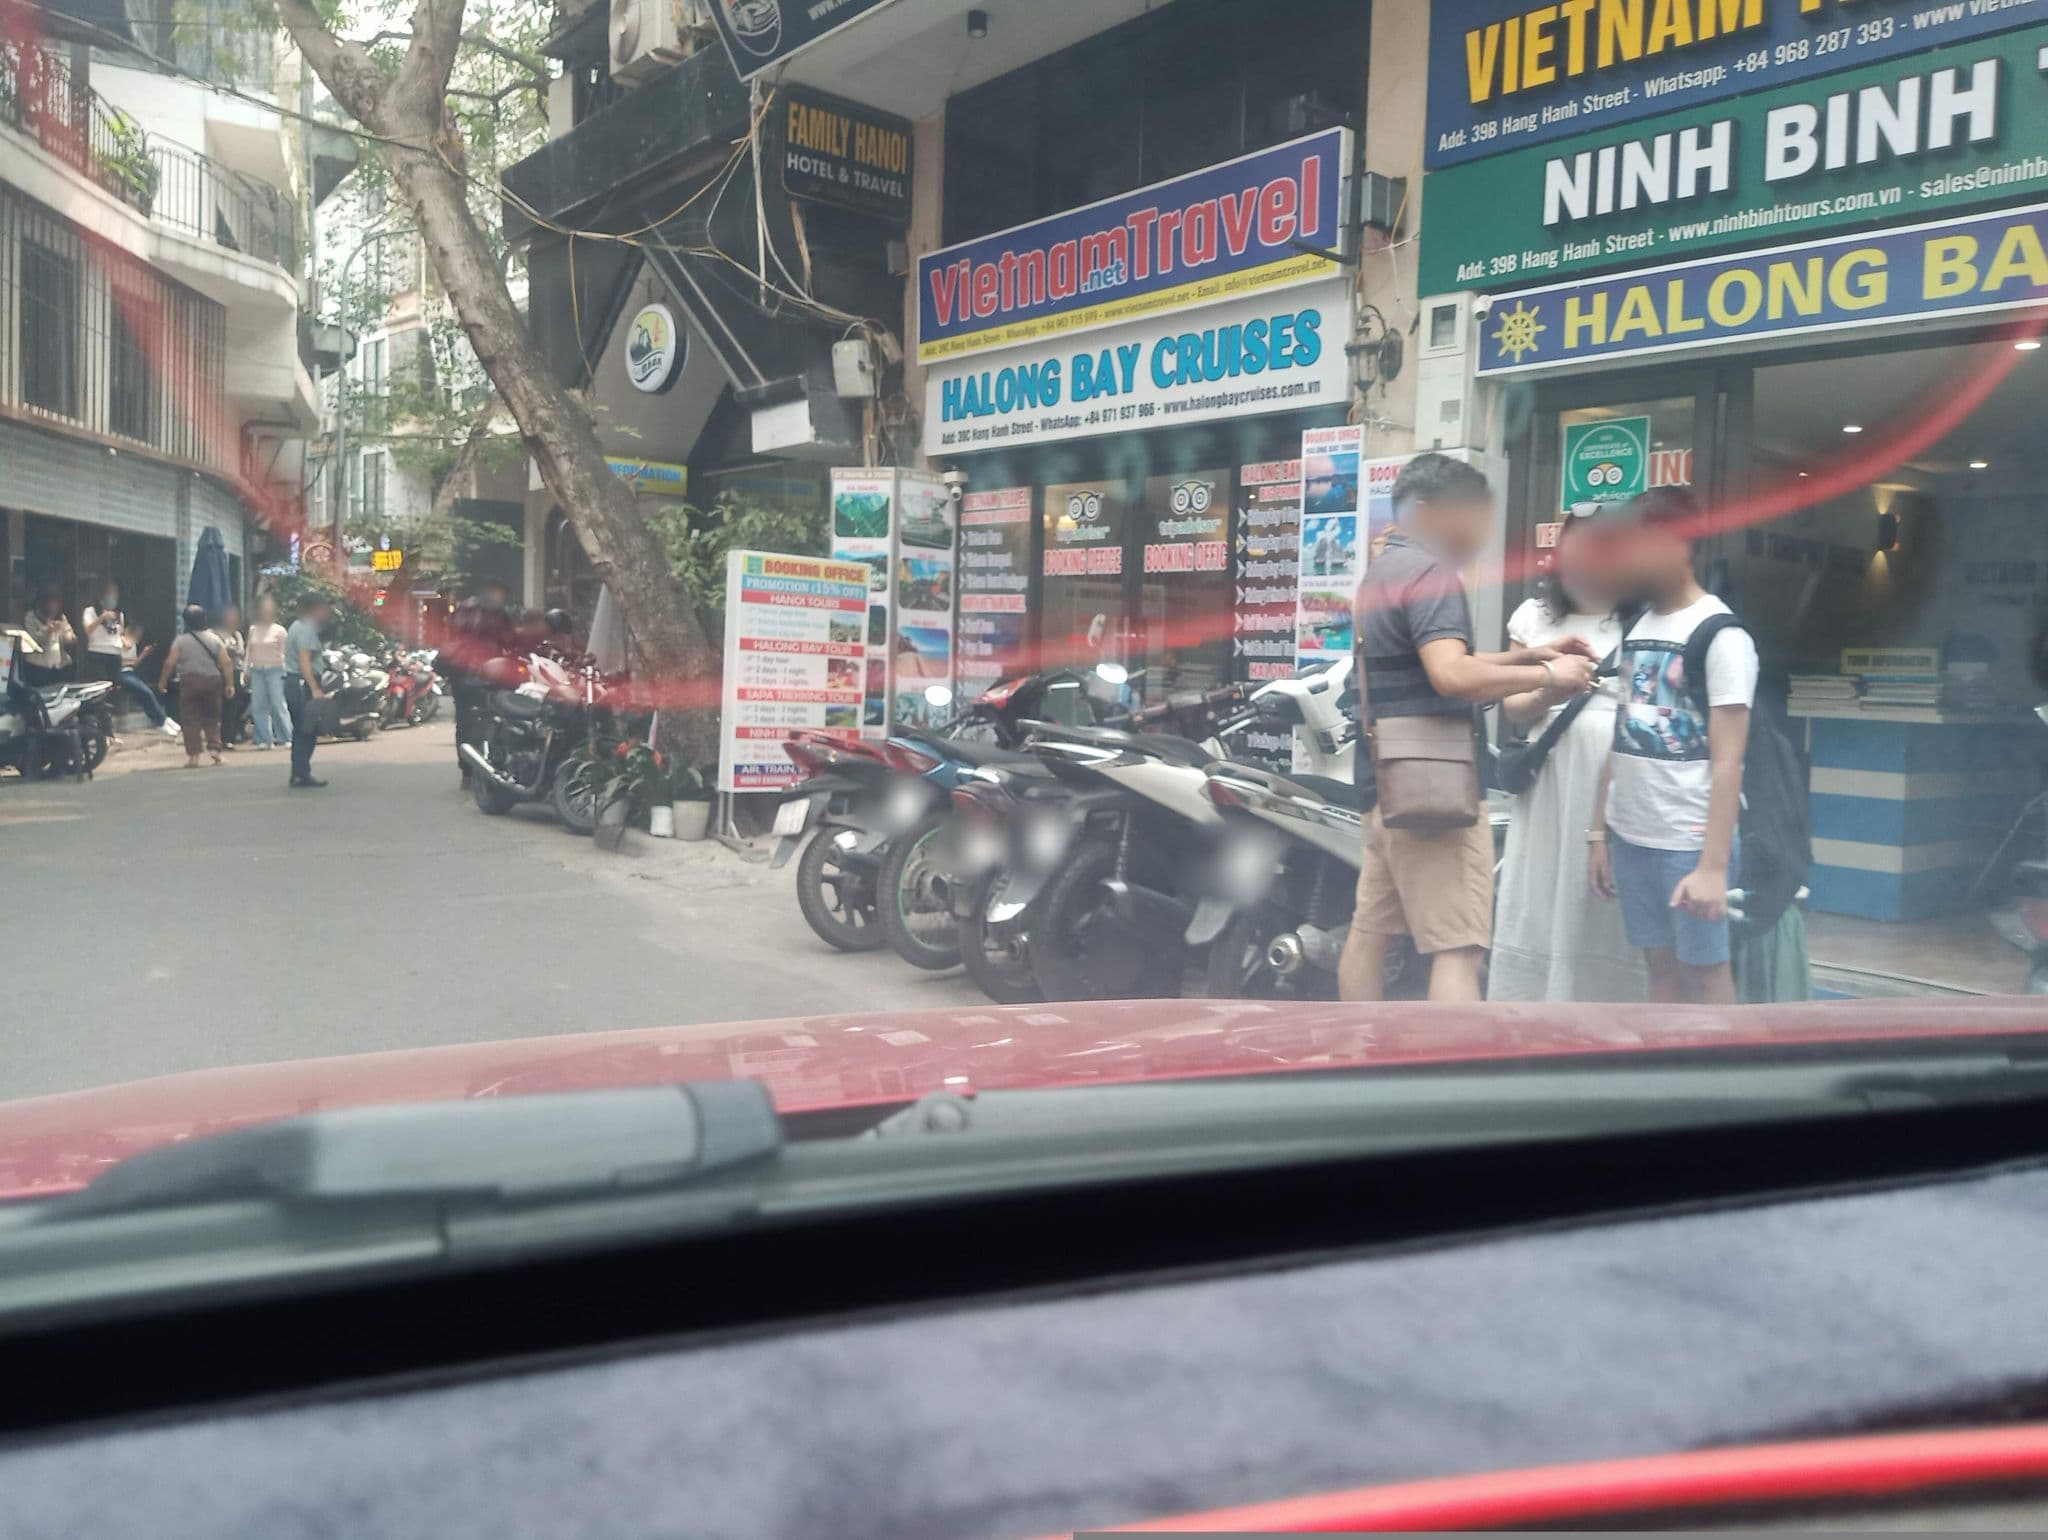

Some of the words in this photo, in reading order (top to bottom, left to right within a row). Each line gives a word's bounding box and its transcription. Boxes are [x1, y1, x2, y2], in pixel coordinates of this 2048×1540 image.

[1438, 133, 1467, 152] Add:
[1471, 120, 1497, 143] 39B
[1502, 113, 1537, 135] Hang
[1541, 99, 1578, 125] Hanh
[1582, 87, 1630, 115] Street
[1644, 65, 1727, 98] Whatsapp:
[1732, 50, 1768, 73] +84
[1775, 39, 1809, 67] 968
[1815, 28, 1851, 55] 287
[1856, 17, 1894, 46] 393
[788, 101, 850, 158] FAMILY
[855, 121, 908, 175] HANOI
[1543, 120, 1733, 226] NINH
[1765, 58, 1998, 182] BINH
[787, 151, 834, 180] HOTEL
[838, 166, 849, 183] &
[854, 170, 904, 198] TRAVEL
[930, 154, 1321, 328] VietnamTravel
[1456, 263, 1486, 282] Add:
[1490, 256, 1517, 276] 39B
[1521, 248, 1558, 270] Hang
[1563, 238, 1600, 262] Hanh
[1605, 228, 1655, 254] Street
[1669, 186, 1901, 242] www.ninhbinhtours.com.vn
[1564, 248, 1889, 349] HALONG
[942, 358, 1061, 423] HALONG
[1071, 343, 1141, 402] BAY
[1151, 309, 1322, 389] CRUISES
[972, 428, 989, 441] Hang
[991, 424, 1009, 437] Hanh
[1011, 420, 1034, 435] Street
[1040, 414, 1081, 432] WhatsApp:
[1084, 410, 1100, 425] +84
[1102, 407, 1117, 422] 971
[1121, 404, 1136, 420] 937
[1138, 402, 1155, 418] 966
[1164, 380, 1321, 414] www.halongbaycruises.com.vn
[746, 577, 809, 594] PROMOTION
[765, 559, 820, 578] BOOKING
[824, 565, 865, 582] OFFICE
[1044, 548, 1086, 577] BOOKING
[1087, 546, 1122, 575] OFFICE
[1144, 542, 1195, 573] BOOKING
[769, 592, 806, 606] HANOI
[807, 596, 841, 609] TOURS
[753, 639, 801, 652] HALONG
[801, 642, 820, 654] BAY
